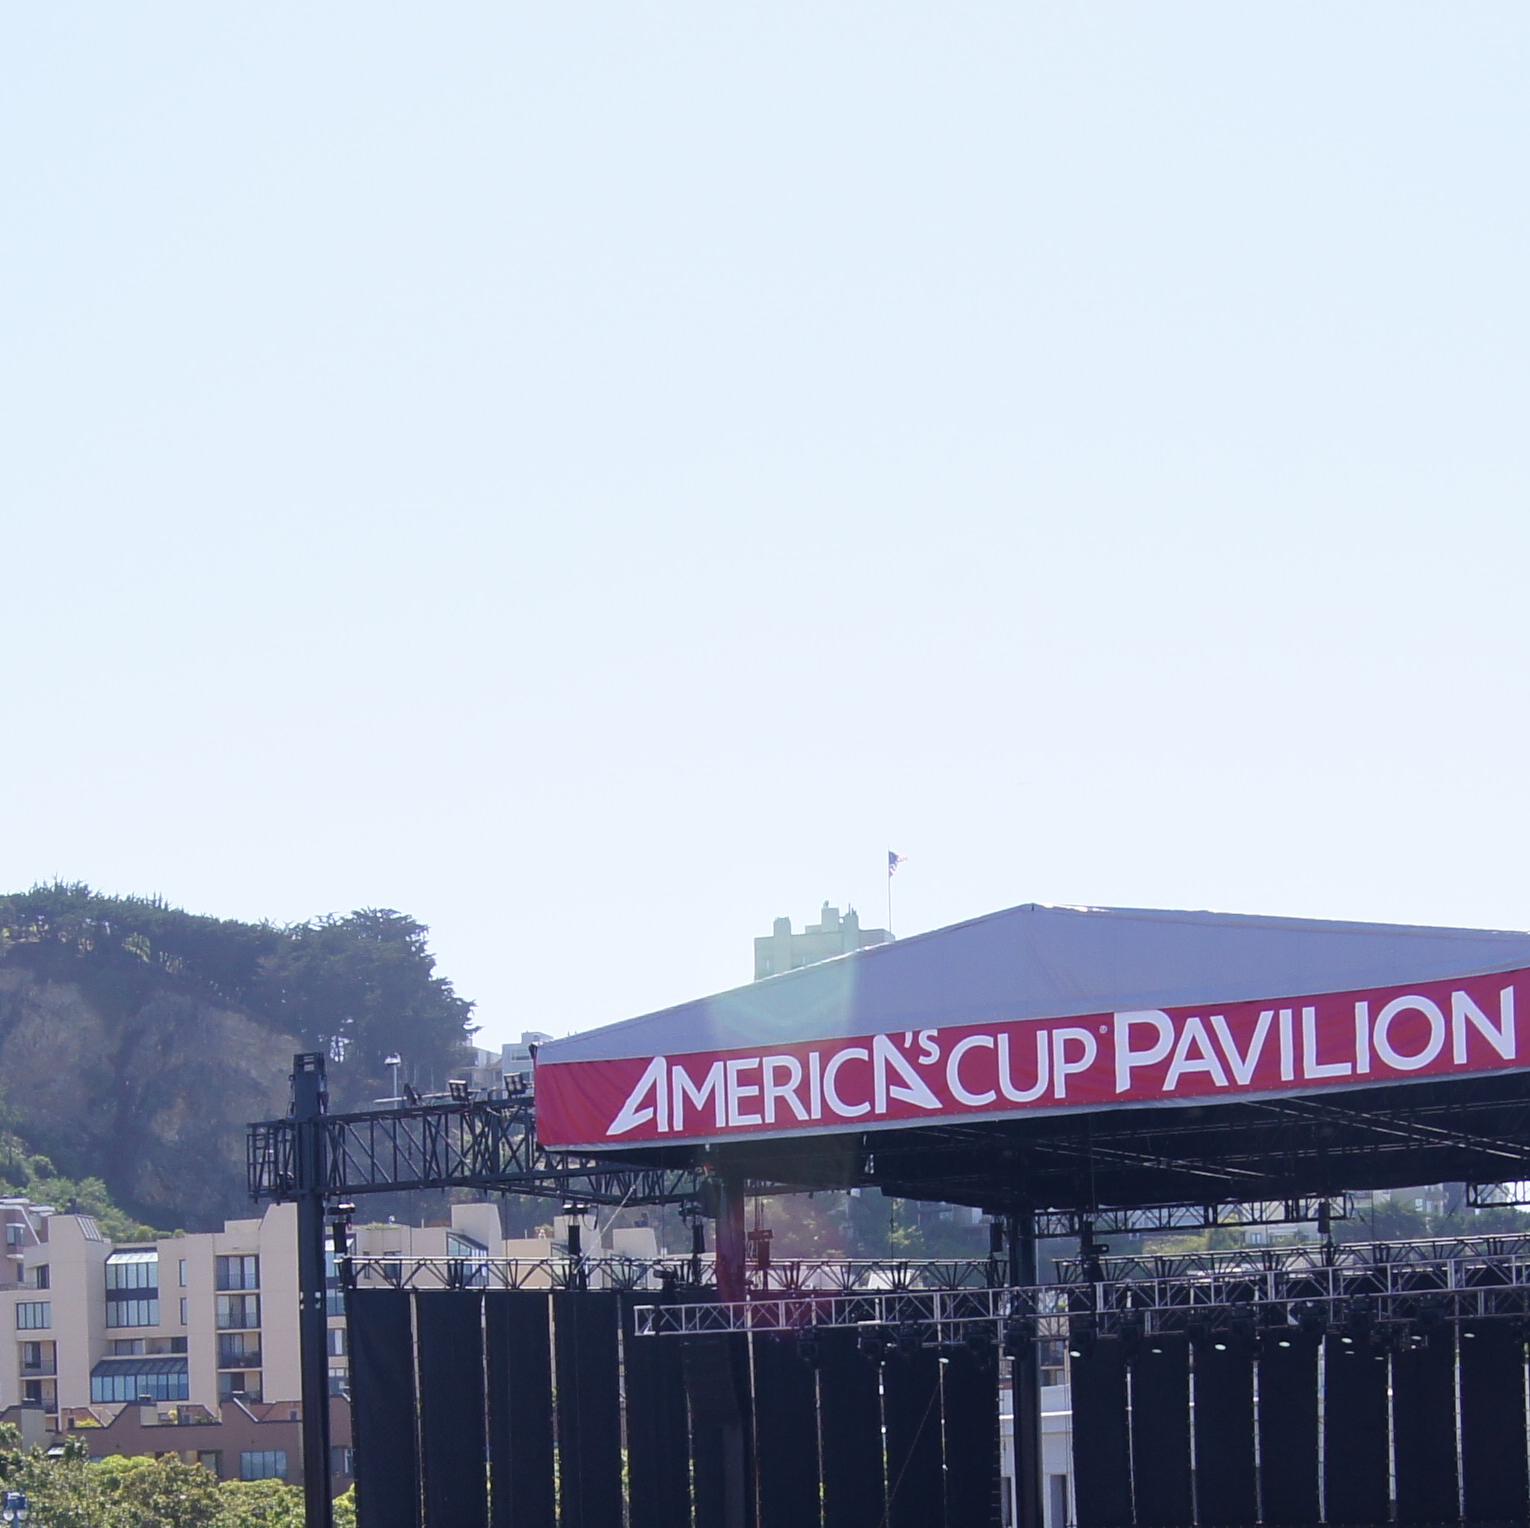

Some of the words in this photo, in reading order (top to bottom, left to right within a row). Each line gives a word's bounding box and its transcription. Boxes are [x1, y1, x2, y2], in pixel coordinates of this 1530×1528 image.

[606, 1029, 943, 1136] AMERICA'S
[946, 1027, 1099, 1106] CUP
[1113, 985, 1517, 1093] PAVILION
